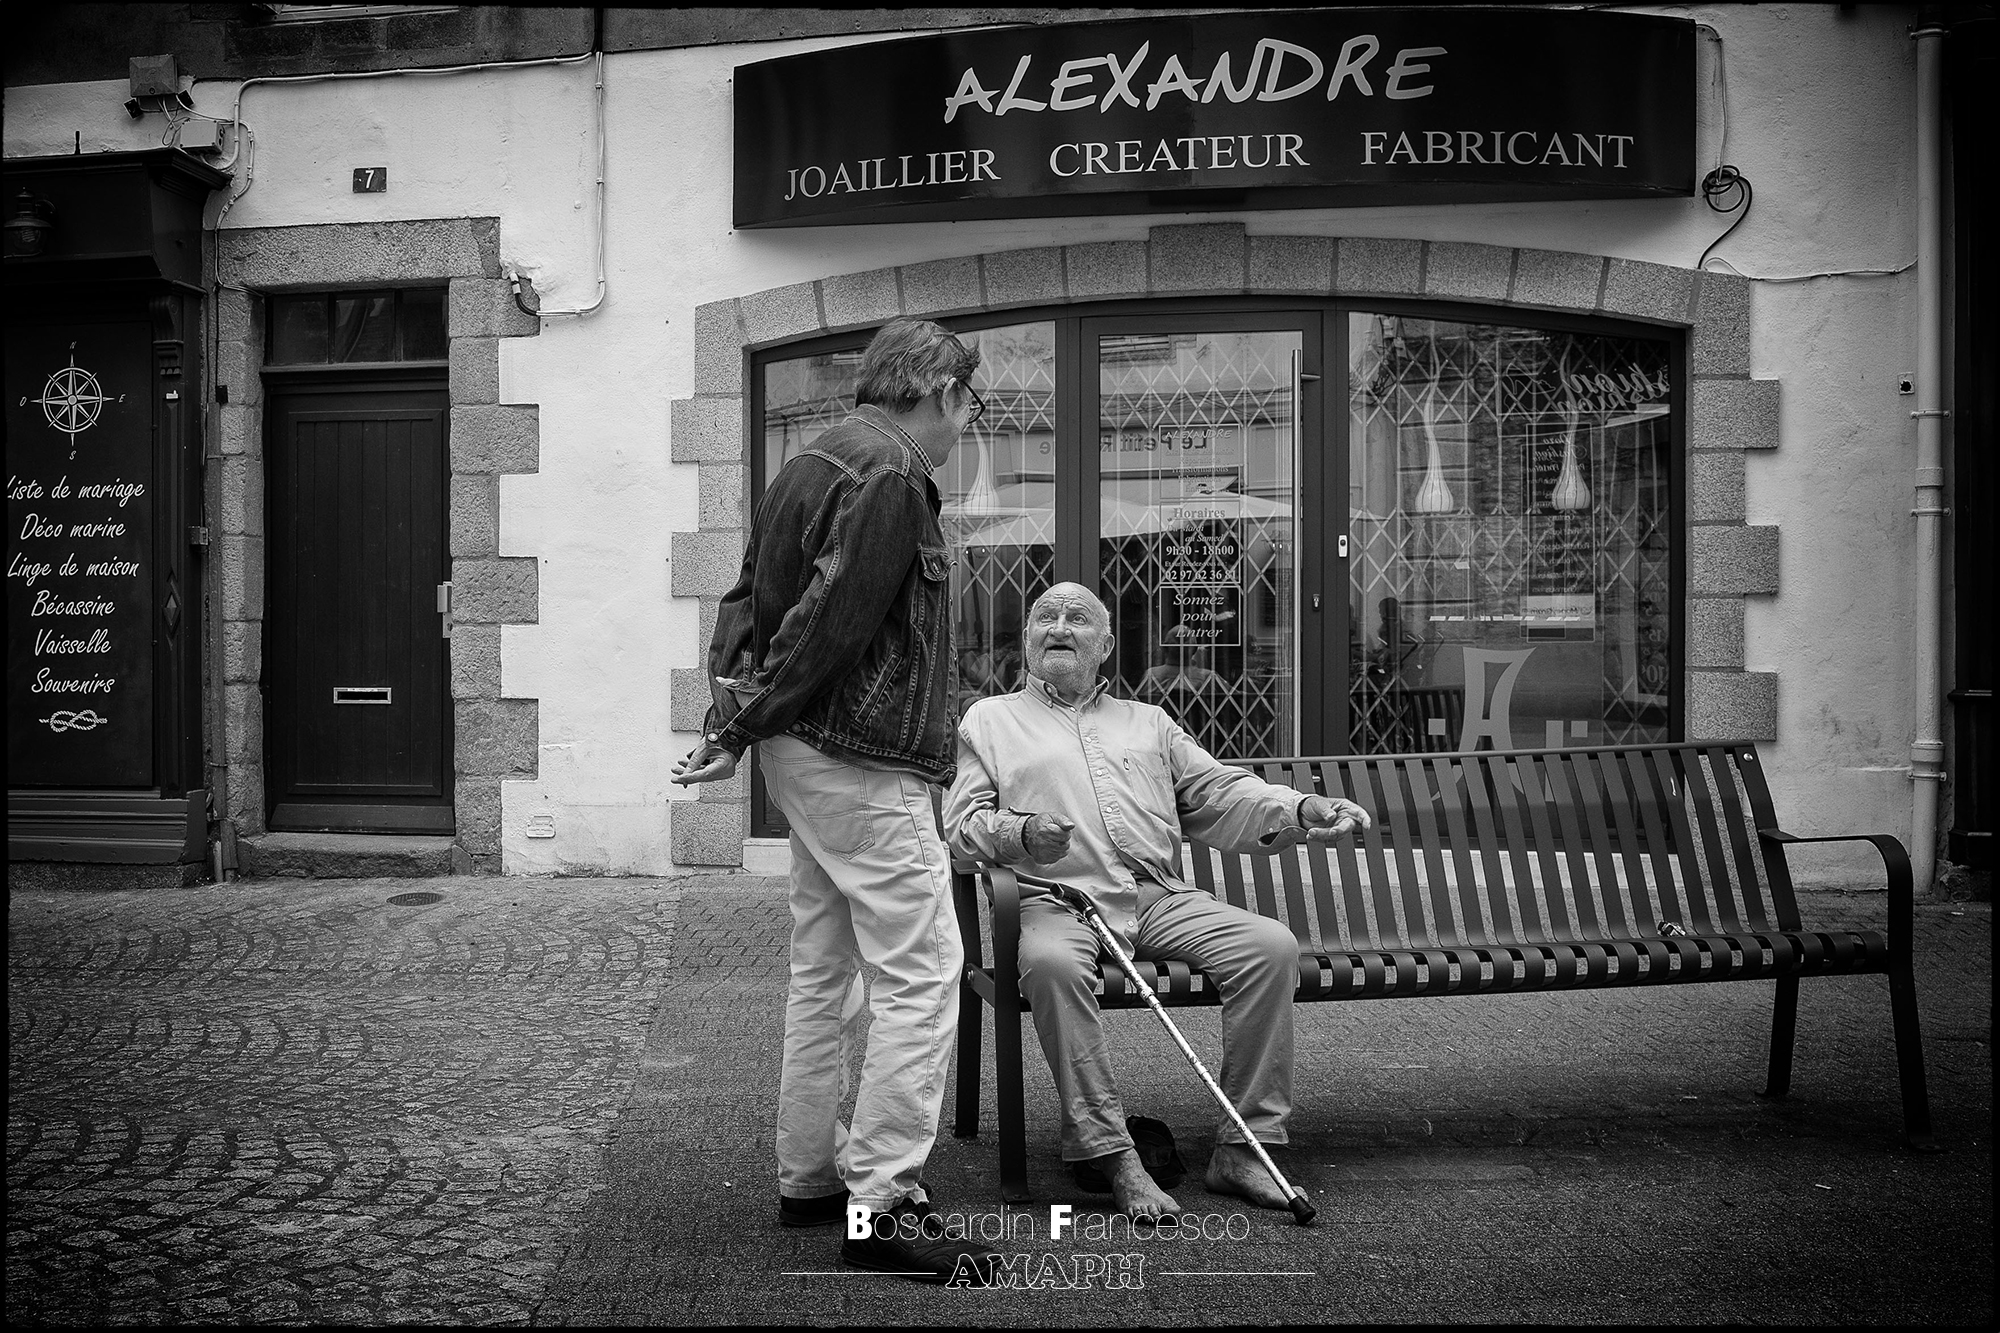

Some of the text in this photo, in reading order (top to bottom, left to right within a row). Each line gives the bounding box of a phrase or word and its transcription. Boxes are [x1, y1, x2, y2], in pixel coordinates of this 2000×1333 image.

[944, 35, 1449, 124] ALEXANDRE
[784, 131, 1634, 201] JOAILLIER CREATEUR FABRICANT
[365, 170, 375, 189] 7
[69, 341, 77, 350] N
[118, 394, 127, 403] E
[1165, 428, 1233, 439] ALEXANDRE
[69, 450, 77, 460] S
[51, 474, 72, 500] de
[77, 477, 146, 508] mariage
[1173, 507, 1226, 519] Horaires
[20, 512, 127, 541] Déco marine
[1165, 545, 1192, 556] 9h30
[1202, 545, 1235, 556] 18h00
[7, 551, 140, 587] Linge de maison
[1164, 570, 1178, 580] 02
[1180, 570, 1193, 580] 97
[1195, 570, 1207, 580] 62
[1209, 570, 1223, 580] 36
[31, 590, 115, 618] Bécassine
[1173, 593, 1225, 606] Sonnez
[1182, 611, 1216, 622] pour
[1175, 627, 1223, 638] Entrer
[34, 629, 112, 656] Vaisselle
[31, 667, 115, 694] Souvenirs
